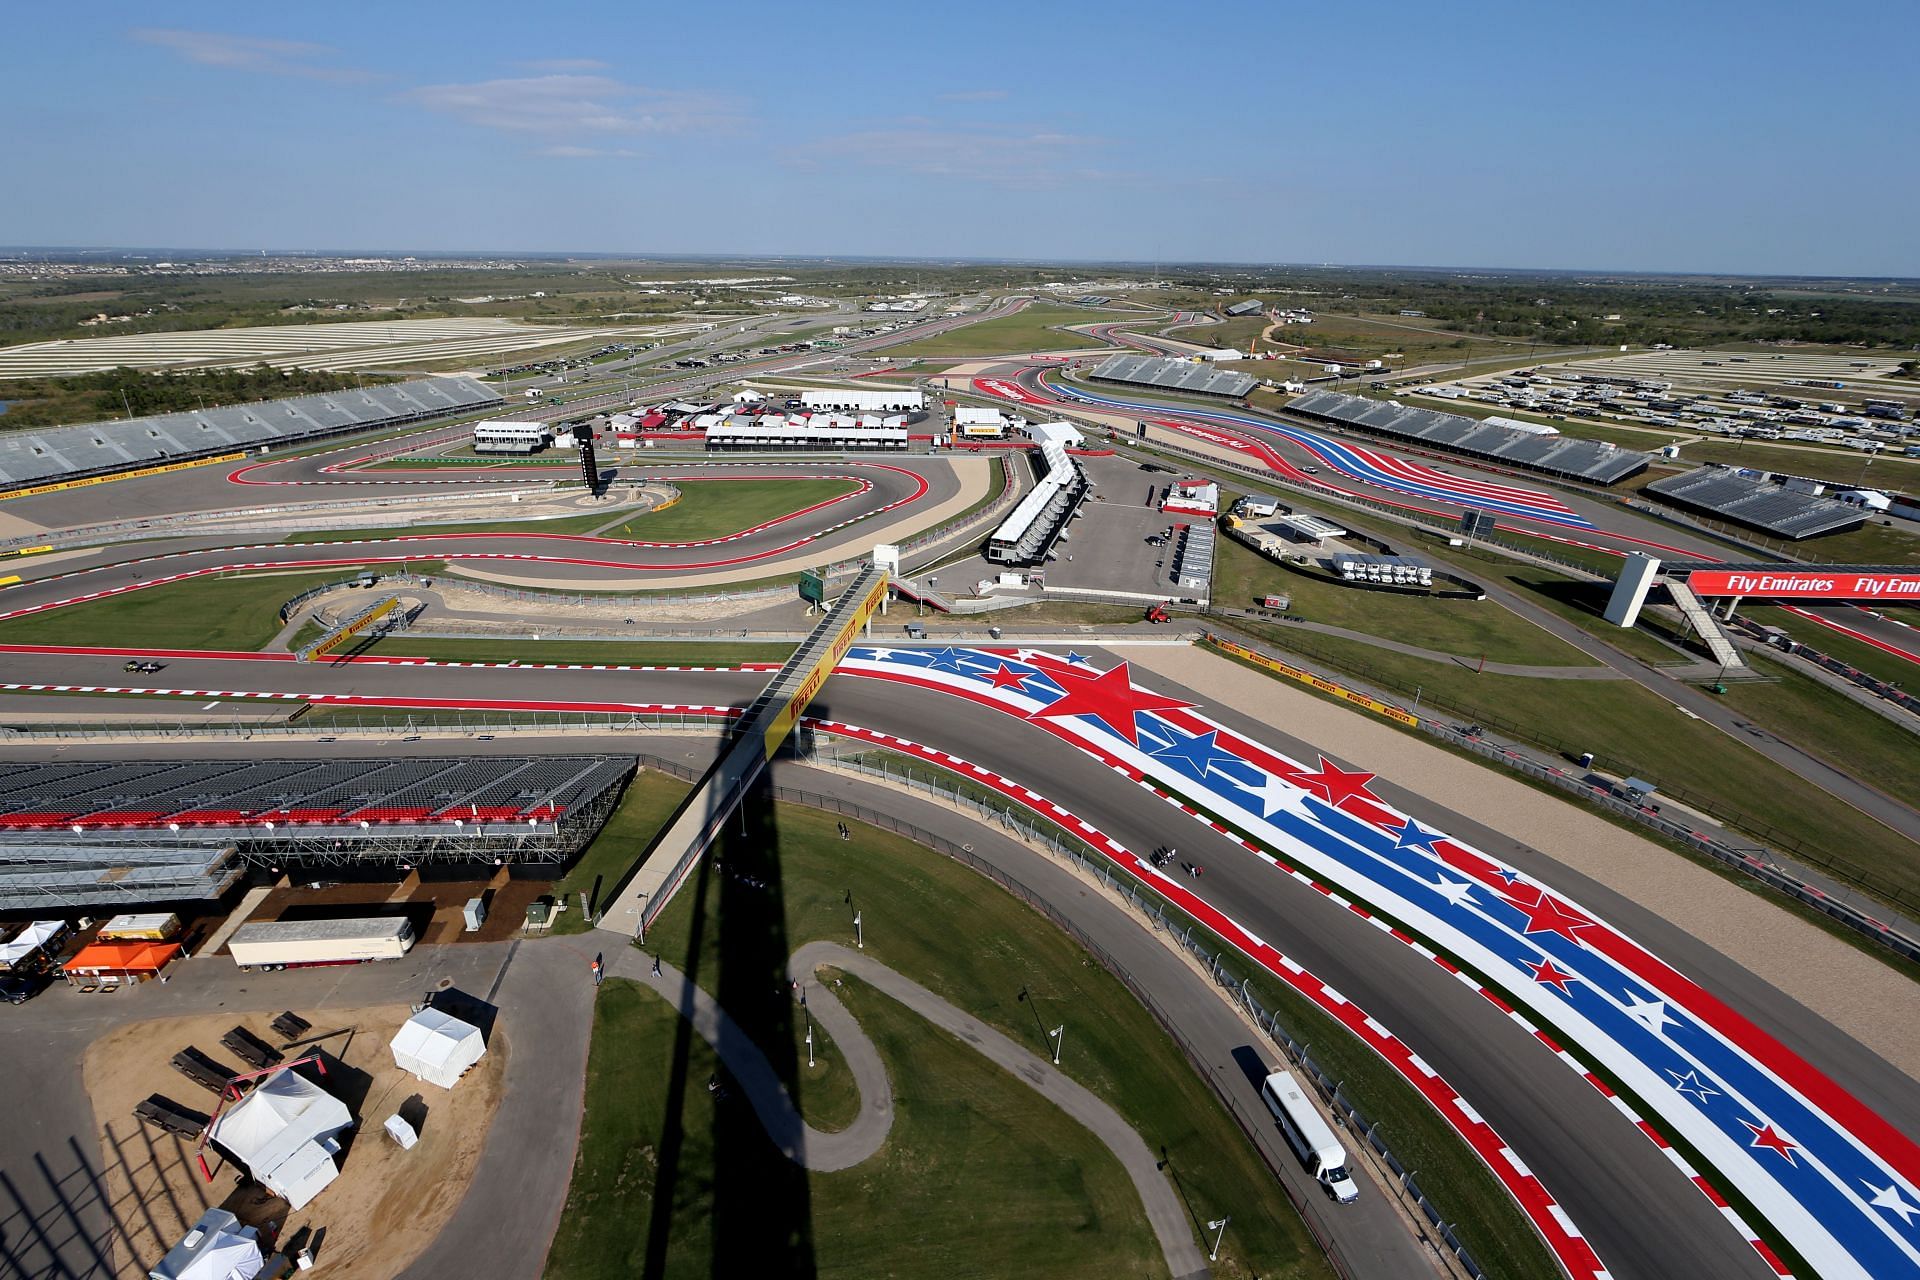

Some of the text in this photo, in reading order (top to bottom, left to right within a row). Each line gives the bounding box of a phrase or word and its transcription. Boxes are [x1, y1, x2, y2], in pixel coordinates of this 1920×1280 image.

[1727, 576, 1920, 596] Fly Emirates Fly Emi
[316, 614, 373, 655] PIRELLI PIRELLI
[790, 580, 884, 720] PIRELLI PIRELLI PIRELLI
[1221, 642, 1410, 722] PIRELLI PIRELLI PIRELLI PIRELLI PIRELLI PIRELLI
